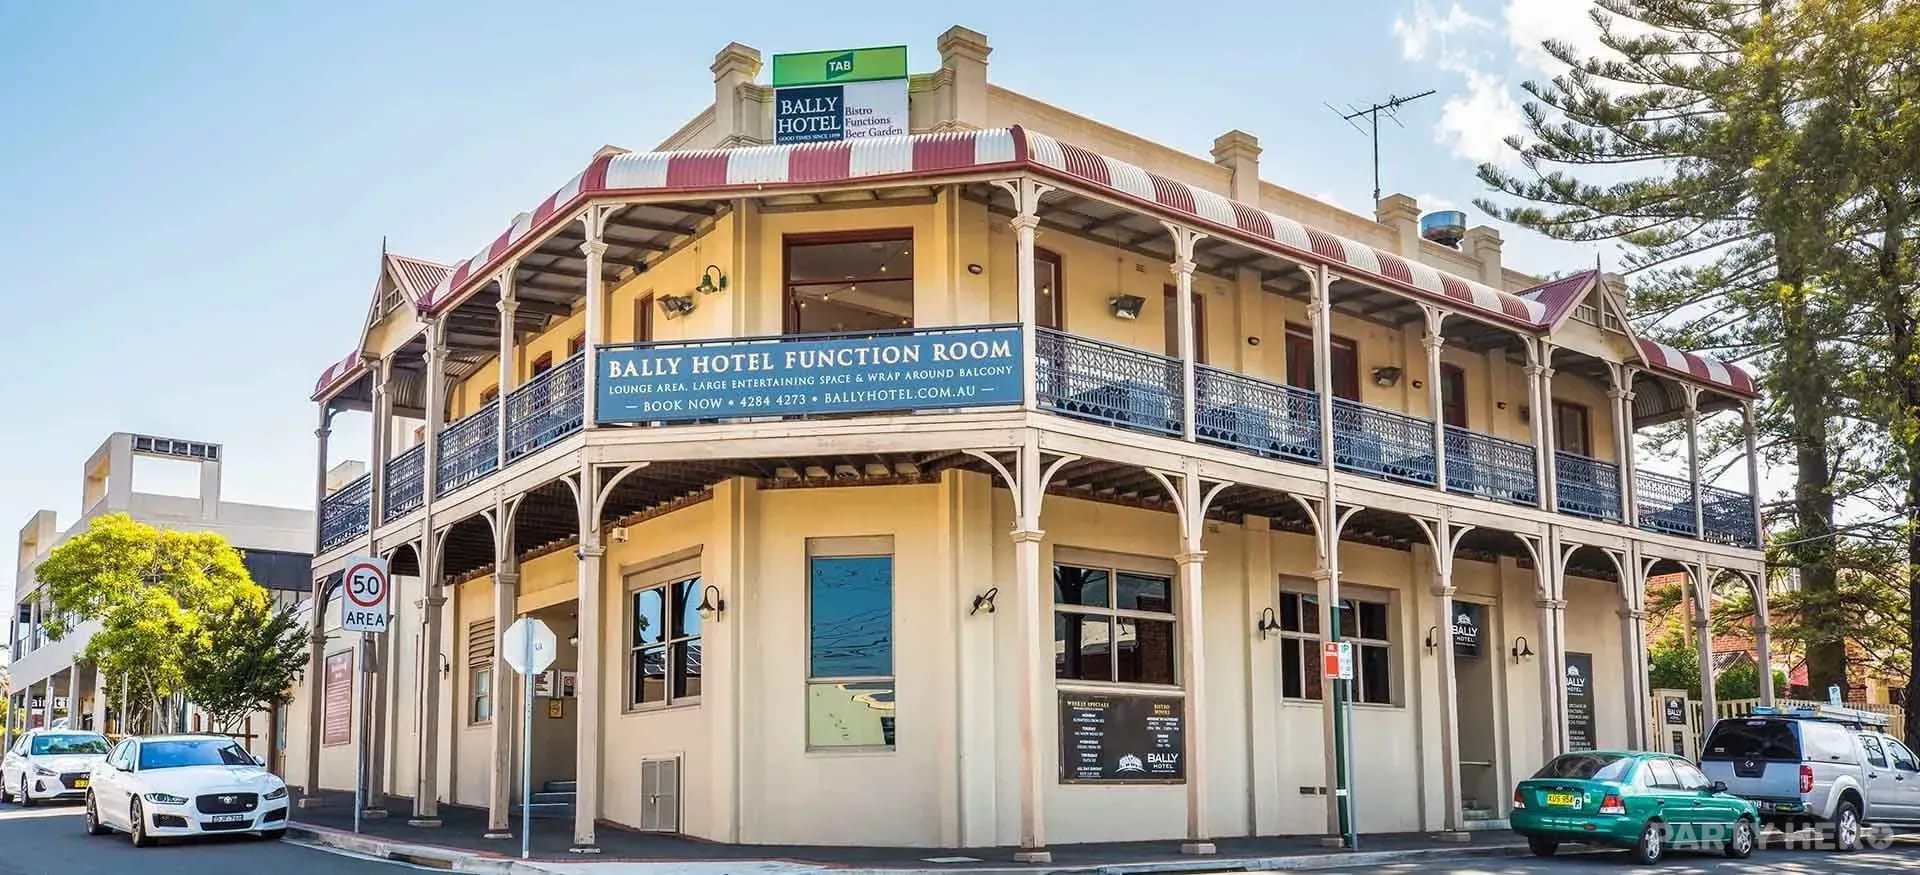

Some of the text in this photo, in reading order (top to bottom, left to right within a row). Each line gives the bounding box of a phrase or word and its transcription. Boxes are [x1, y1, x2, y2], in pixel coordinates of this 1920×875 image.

[829, 61, 851, 72] TAB
[781, 96, 838, 115] BALLY
[845, 106, 873, 116] Bistro
[778, 115, 841, 133] HOTEL
[845, 116, 891, 127] Functions
[845, 125, 903, 138] Beer Garden
[609, 340, 1012, 379] BALLY HOTEL FUNCTION ROOM
[609, 384, 653, 395] LOUNGE
[693, 380, 727, 391] LARGE
[732, 376, 815, 389] ENTERTAINING
[820, 374, 851, 385] SPACE
[856, 374, 863, 383] &
[868, 371, 901, 381] WRAP
[905, 369, 954, 380] AROUND
[960, 366, 1013, 377] BALCONY
[644, 385, 975, 412] BOOK NOW 4284 4273 BALLYHOTEL.COM.AU
[353, 575, 379, 595] 50
[346, 611, 384, 626] AREA
[1566, 678, 1585, 687] ALLY
[1147, 753, 1179, 763] BALLY
